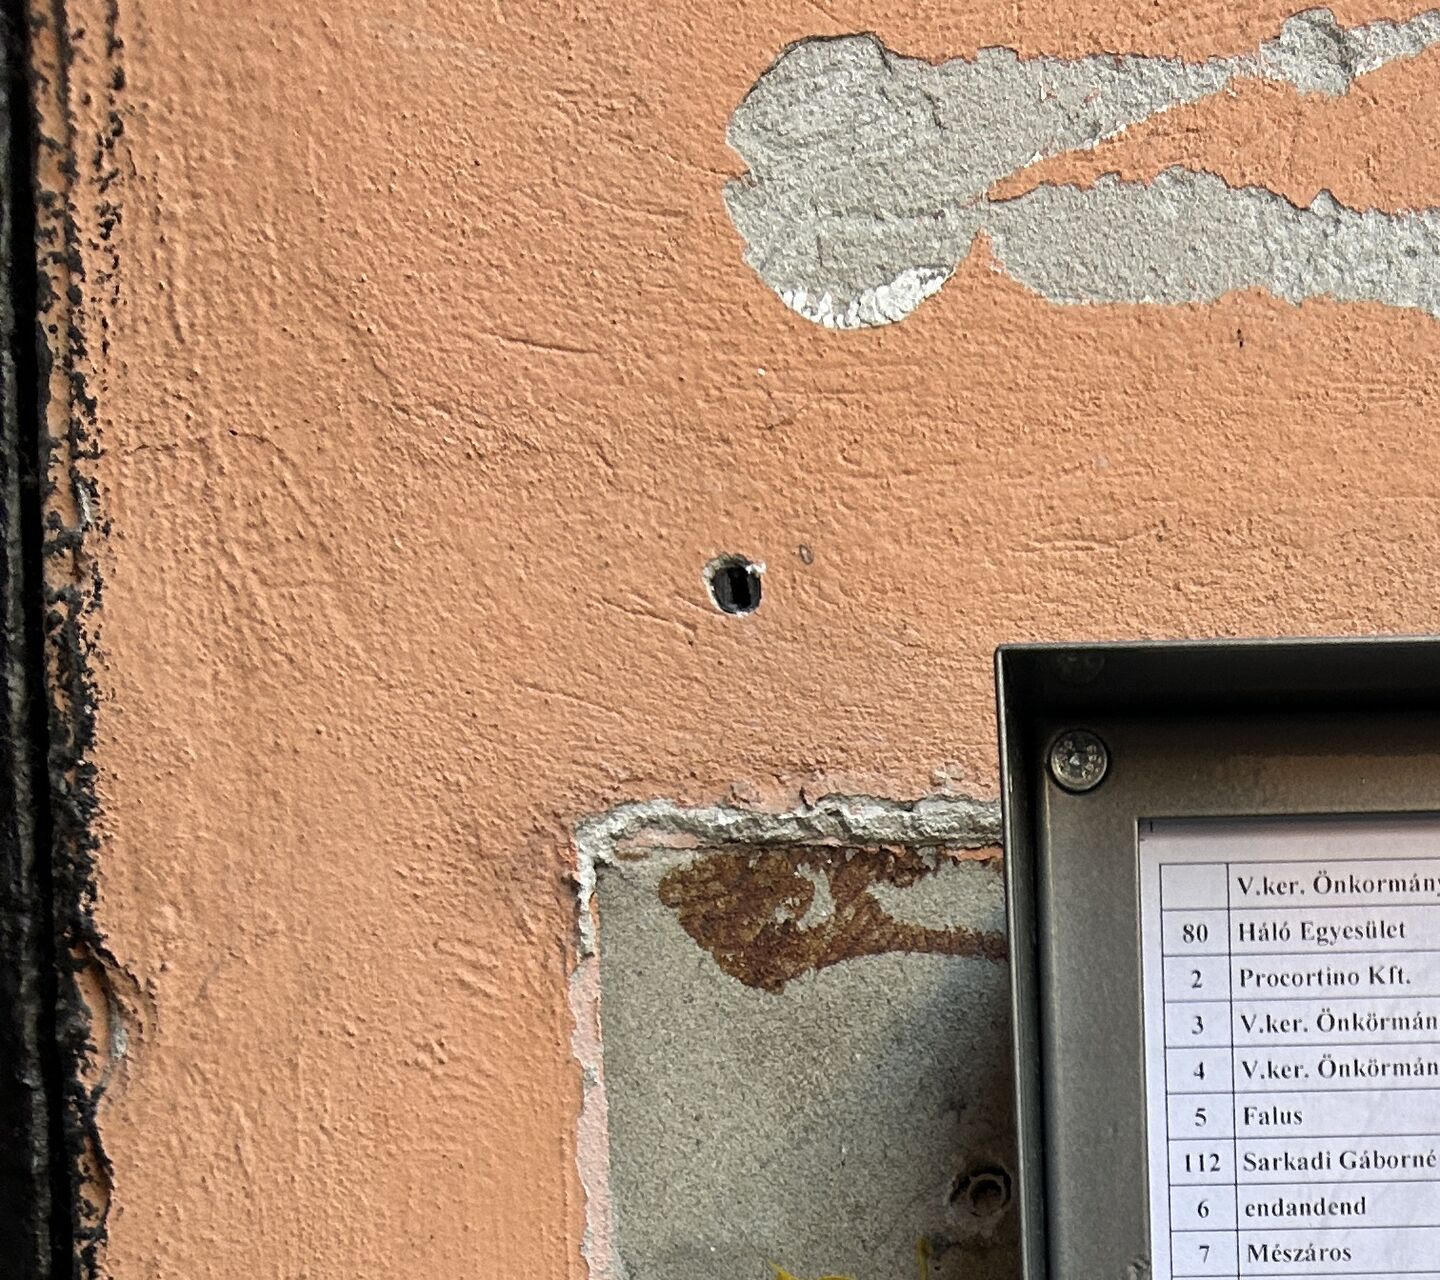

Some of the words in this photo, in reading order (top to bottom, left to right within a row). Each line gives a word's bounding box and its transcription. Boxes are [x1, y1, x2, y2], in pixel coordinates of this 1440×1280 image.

[1191, 969, 1203, 989] 2
[1240, 966, 1360, 988] Procortino
[1368, 965, 1411, 985] Kft.
[1191, 1015, 1204, 1035] 3
[1193, 1061, 1205, 1081] 4
[1197, 1200, 1210, 1219] 6
[1245, 1196, 1366, 1218] endandend
[1198, 1244, 1211, 1264] 7
[1247, 1242, 1352, 1264] Mészáros
